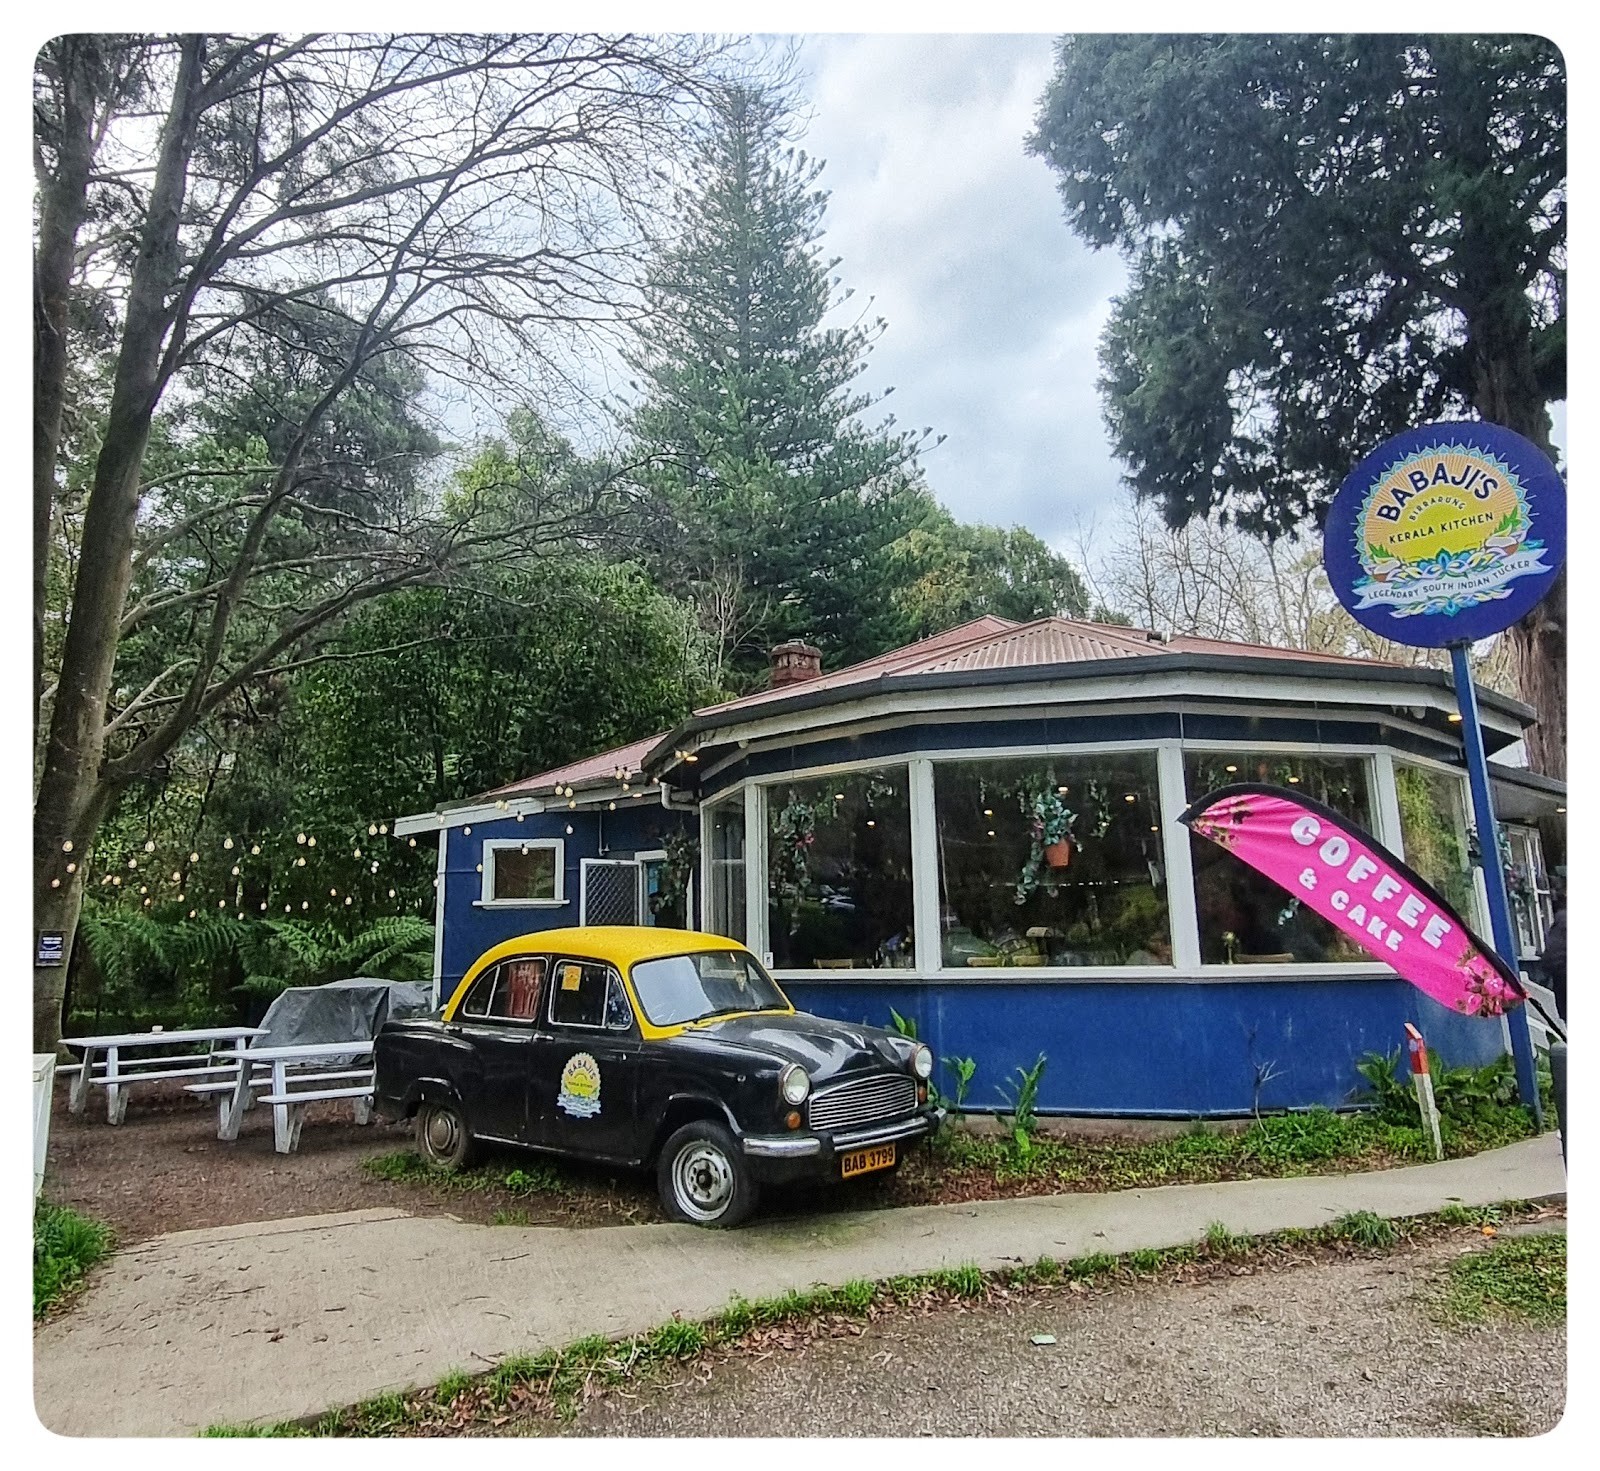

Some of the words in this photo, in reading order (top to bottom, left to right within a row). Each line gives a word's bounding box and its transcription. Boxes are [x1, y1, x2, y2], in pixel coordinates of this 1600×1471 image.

[1376, 462, 1498, 522] BABAJI'S
[1389, 526, 1434, 544] KERALA
[1440, 511, 1494, 532] KITCHEN
[1368, 589, 1419, 600] LEGENDARY
[1422, 582, 1454, 593] SOUTH
[1457, 577, 1490, 590] INDIAN
[1493, 560, 1530, 579] TUCKER
[1290, 816, 1451, 949] COFFEE
[1299, 867, 1318, 890] &
[1330, 890, 1404, 951] CAKE
[844, 1154, 866, 1173] BAB
[869, 1146, 894, 1167] 3799
